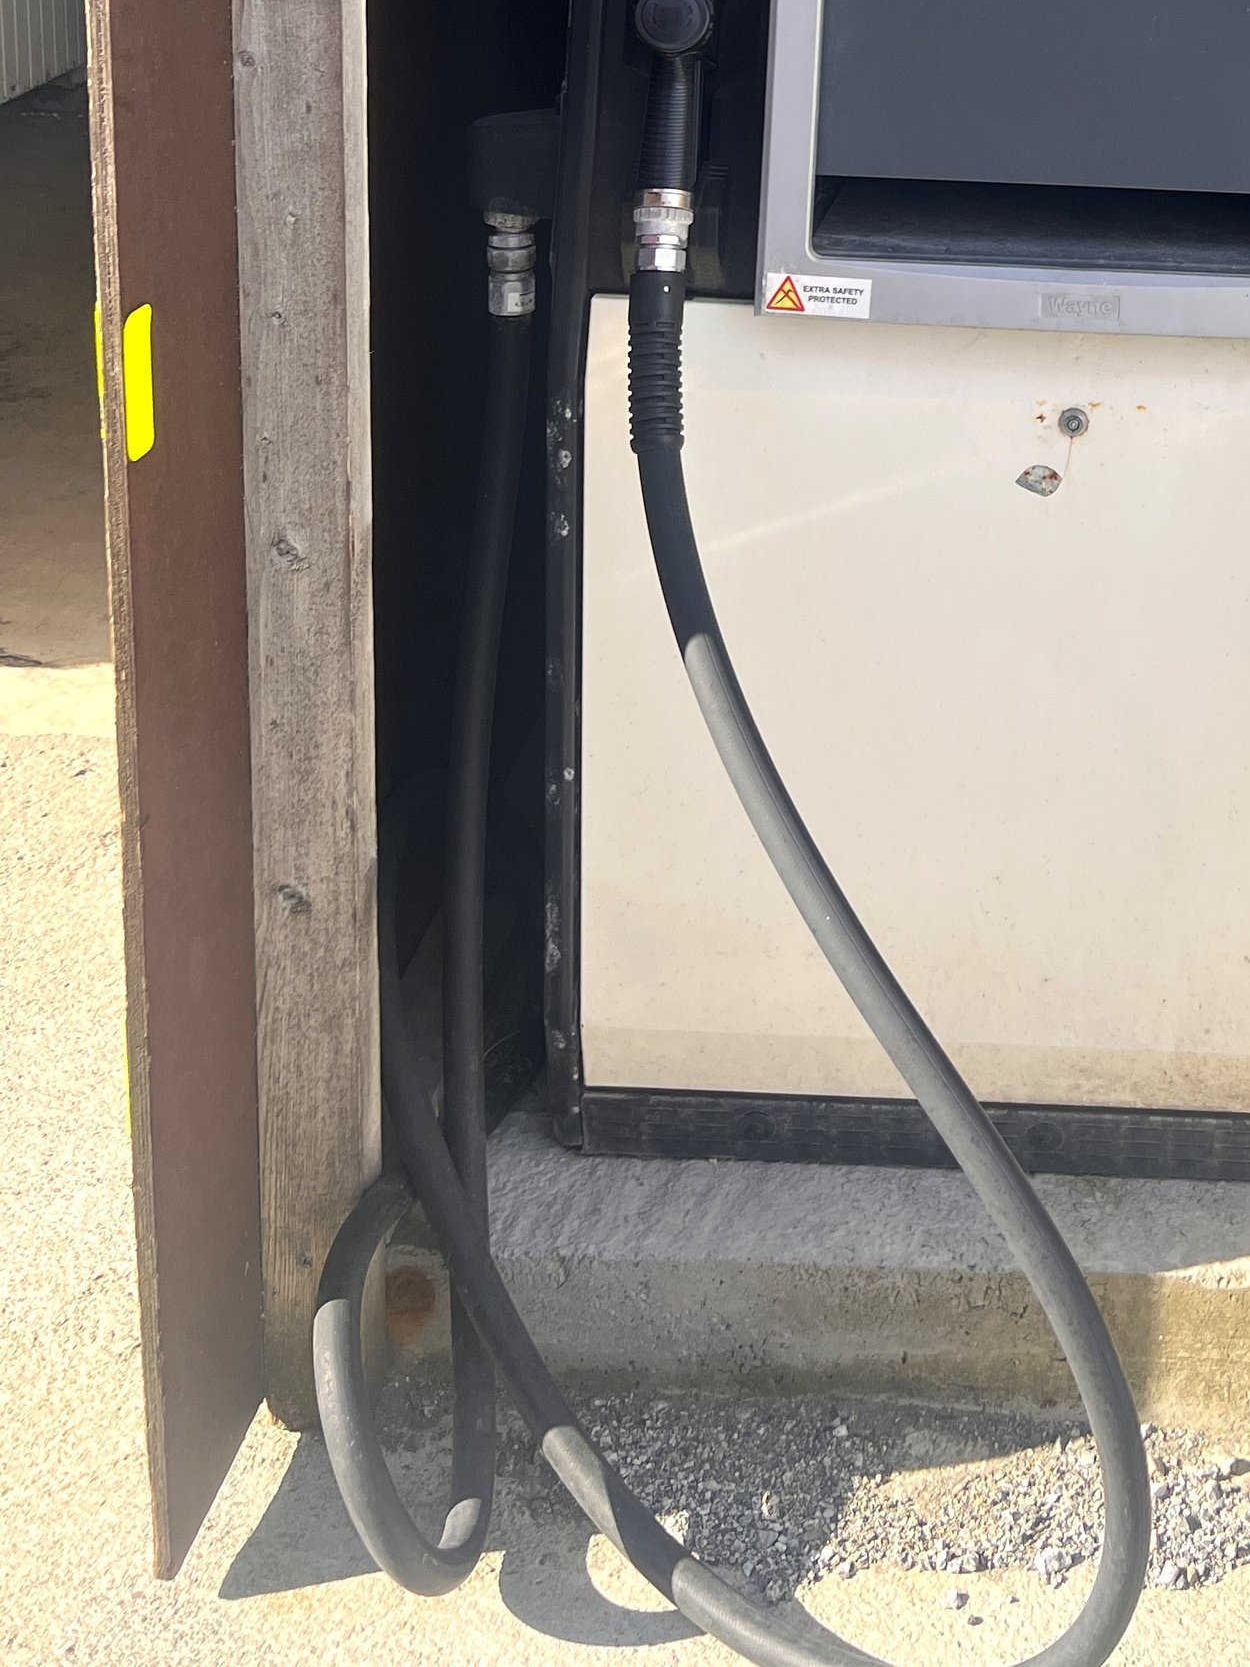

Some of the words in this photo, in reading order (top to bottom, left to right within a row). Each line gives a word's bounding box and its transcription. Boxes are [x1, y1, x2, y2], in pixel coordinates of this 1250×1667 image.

[803, 285, 830, 294] EXTRA
[832, 287, 864, 296] SAFETY
[808, 295, 858, 305] PROTECTED
[1047, 294, 1113, 317] Wayne
